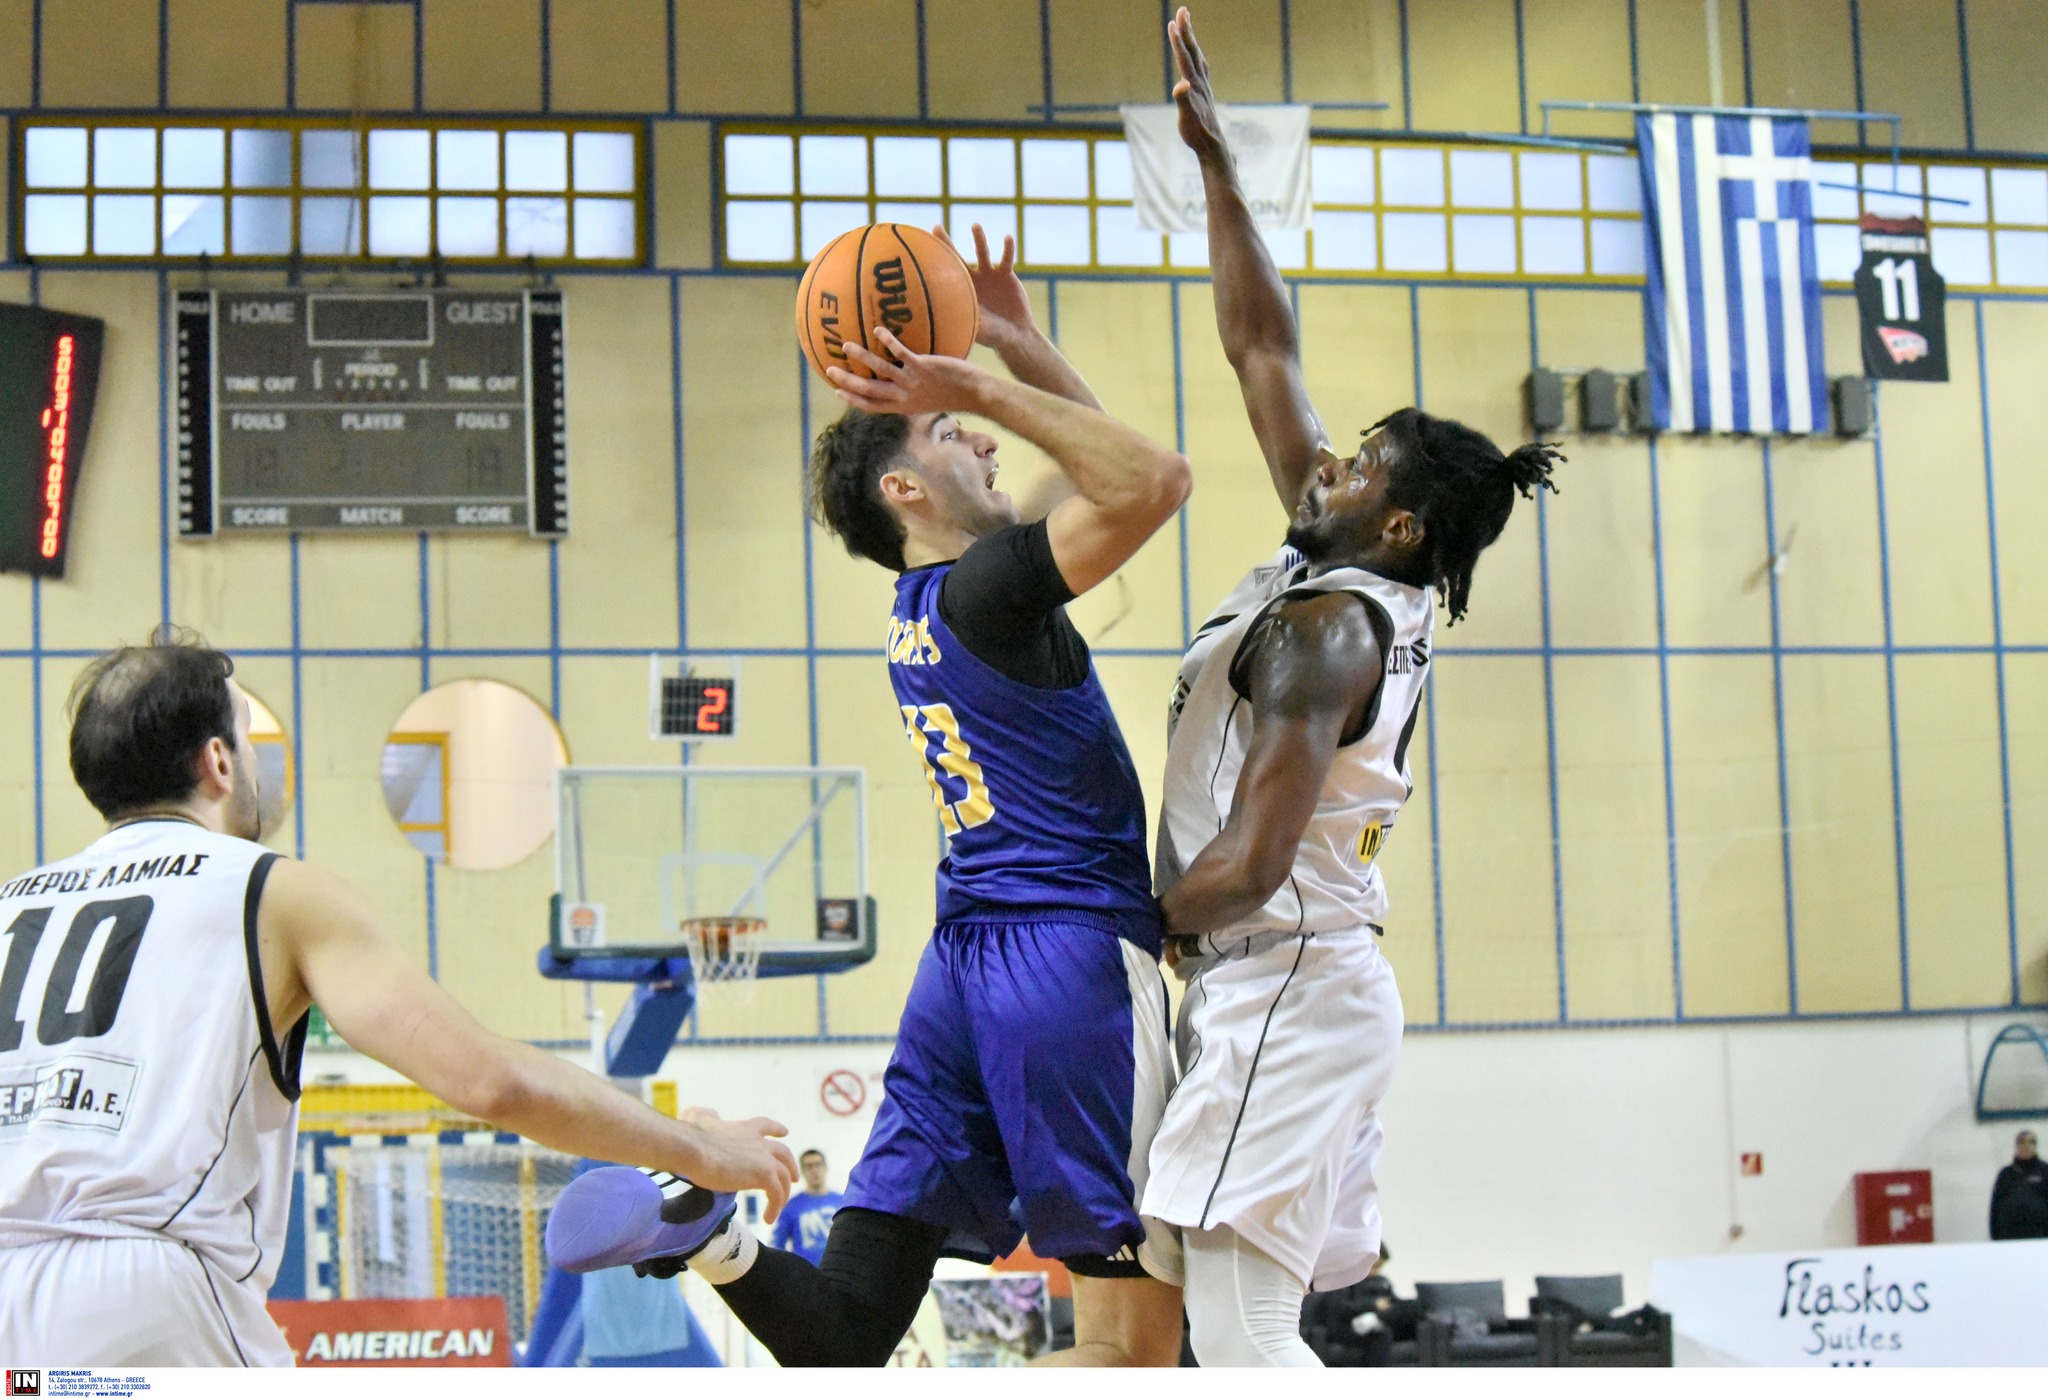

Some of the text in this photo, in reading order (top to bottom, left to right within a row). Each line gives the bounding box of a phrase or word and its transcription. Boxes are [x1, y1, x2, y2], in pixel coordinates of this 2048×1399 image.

[1872, 257, 1921, 322] 11
[230, 302, 296, 323] HOME
[445, 301, 519, 323] GUEST
[224, 377, 298, 392] TIME OUT
[446, 376, 519, 391] TIME OUT
[232, 412, 286, 430] FOULS
[341, 412, 405, 430] PLAYER
[455, 412, 510, 430] FOULS
[232, 507, 288, 524] SCORE
[341, 507, 403, 523] MATCH
[455, 506, 511, 523] SCORE
[697, 687, 728, 732] 2
[97, 854, 209, 889] ΛΑΜΙΑΣ
[0, 894, 154, 1052] 10
[1780, 1258, 1930, 1318] Flaskos
[304, 1329, 494, 1361] AMERICAN
[1803, 1322, 1903, 1355] Suites
